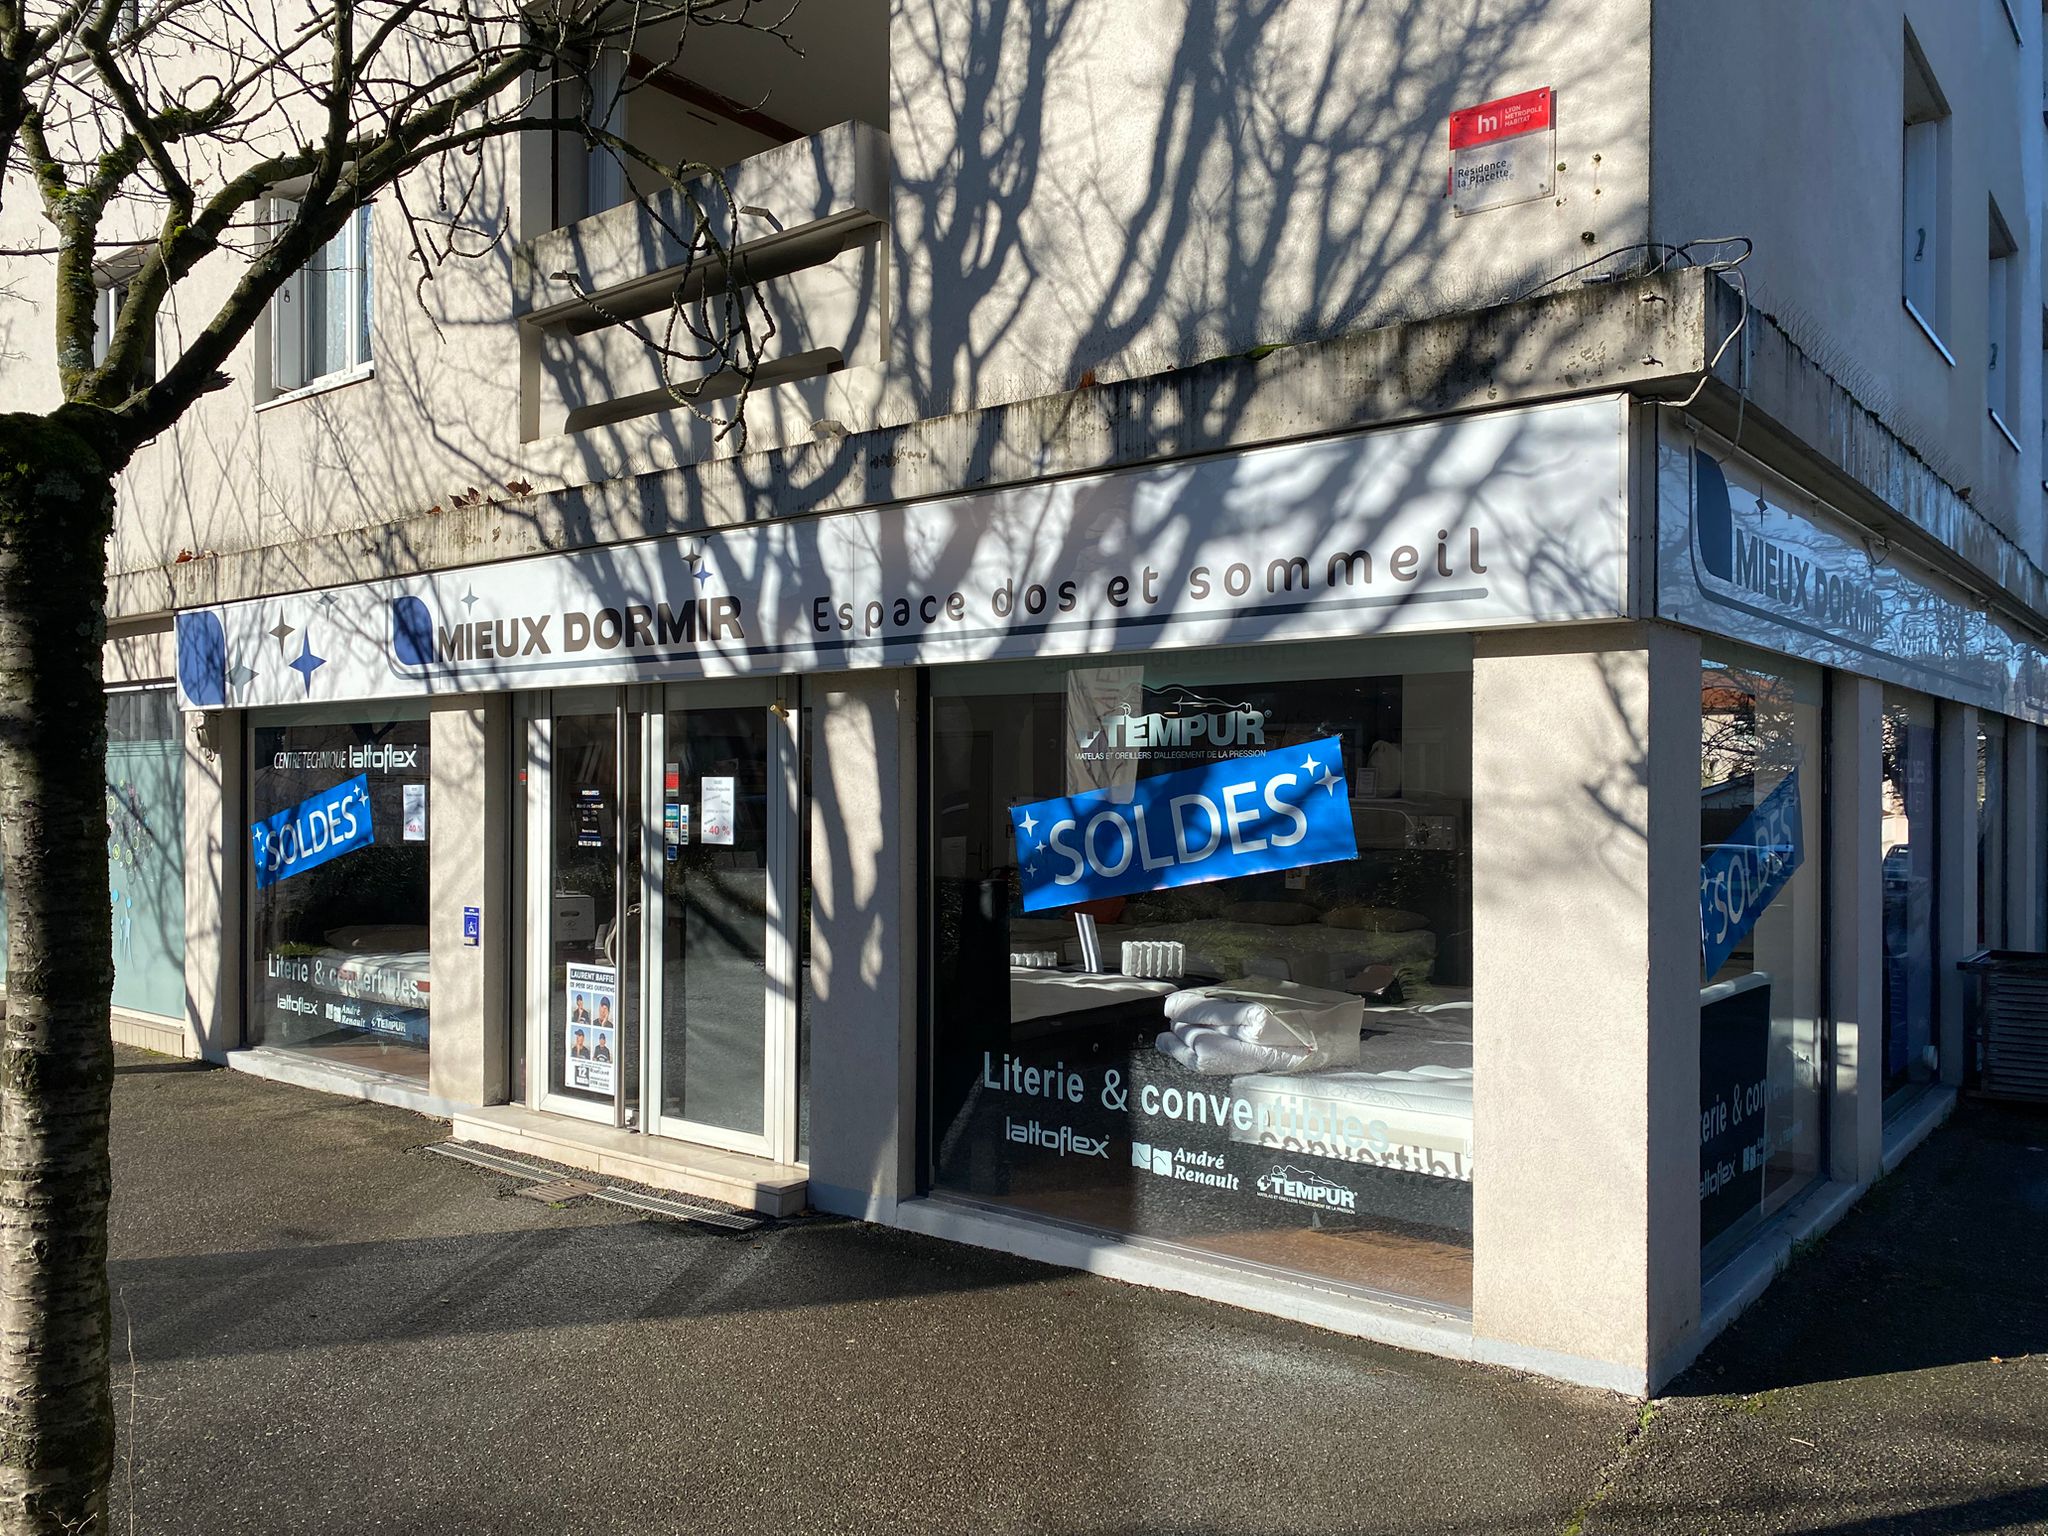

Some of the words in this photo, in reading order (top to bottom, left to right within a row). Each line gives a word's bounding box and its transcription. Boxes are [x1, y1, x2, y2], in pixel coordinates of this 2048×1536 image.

[1504, 105, 1521, 114] LYON
[1504, 115, 1531, 127] HABITAT
[1457, 160, 1507, 178] Résidence
[1457, 180, 1467, 188] la
[1470, 169, 1509, 185] Placette
[813, 591, 965, 637] Espace
[991, 577, 1078, 618] dos
[1106, 566, 1160, 608] et
[1189, 526, 1488, 601] sommeil
[1735, 527, 1810, 614] MIEUX
[1813, 566, 1884, 640] DORMIR
[438, 614, 552, 663] MIEUX
[563, 595, 745, 653] DORMIR
[1101, 709, 1266, 748] TEMPUR
[273, 751, 302, 769] CENTRE
[303, 750, 346, 768] TECHNIQUE
[349, 744, 416, 773] lattoflex
[1115, 752, 1152, 760] OREILLERS
[1207, 751, 1217, 759] DE
[1218, 751, 1229, 759] LA
[1229, 749, 1266, 759] PRESSION
[265, 795, 357, 872] SOLDES
[709, 825, 720, 835] 40
[721, 825, 730, 836] %
[1050, 773, 1308, 886] SOLDES
[1714, 797, 1792, 944] SOLDES
[268, 953, 309, 983] Literie
[314, 959, 325, 987] &
[329, 967, 420, 999] convertibles
[571, 970, 595, 981] LAURENT
[595, 973, 615, 983] BAFFIE
[277, 993, 318, 1016] lattoflex
[341, 1004, 361, 1016] André
[341, 1014, 366, 1028] Renault
[376, 1017, 406, 1033] TEMPUR
[578, 1067, 587, 1077] 12
[984, 1051, 1084, 1103] Literie
[1101, 1069, 1129, 1112] &
[1141, 1084, 1390, 1153] convertibles
[1732, 1084, 1743, 1126] &
[1006, 1116, 1110, 1159] lattoflex
[1173, 1147, 1225, 1170] André
[1174, 1164, 1240, 1191] Renault
[1699, 1153, 1736, 1200] attoflex
[1271, 1176, 1355, 1209] TEMPUR
